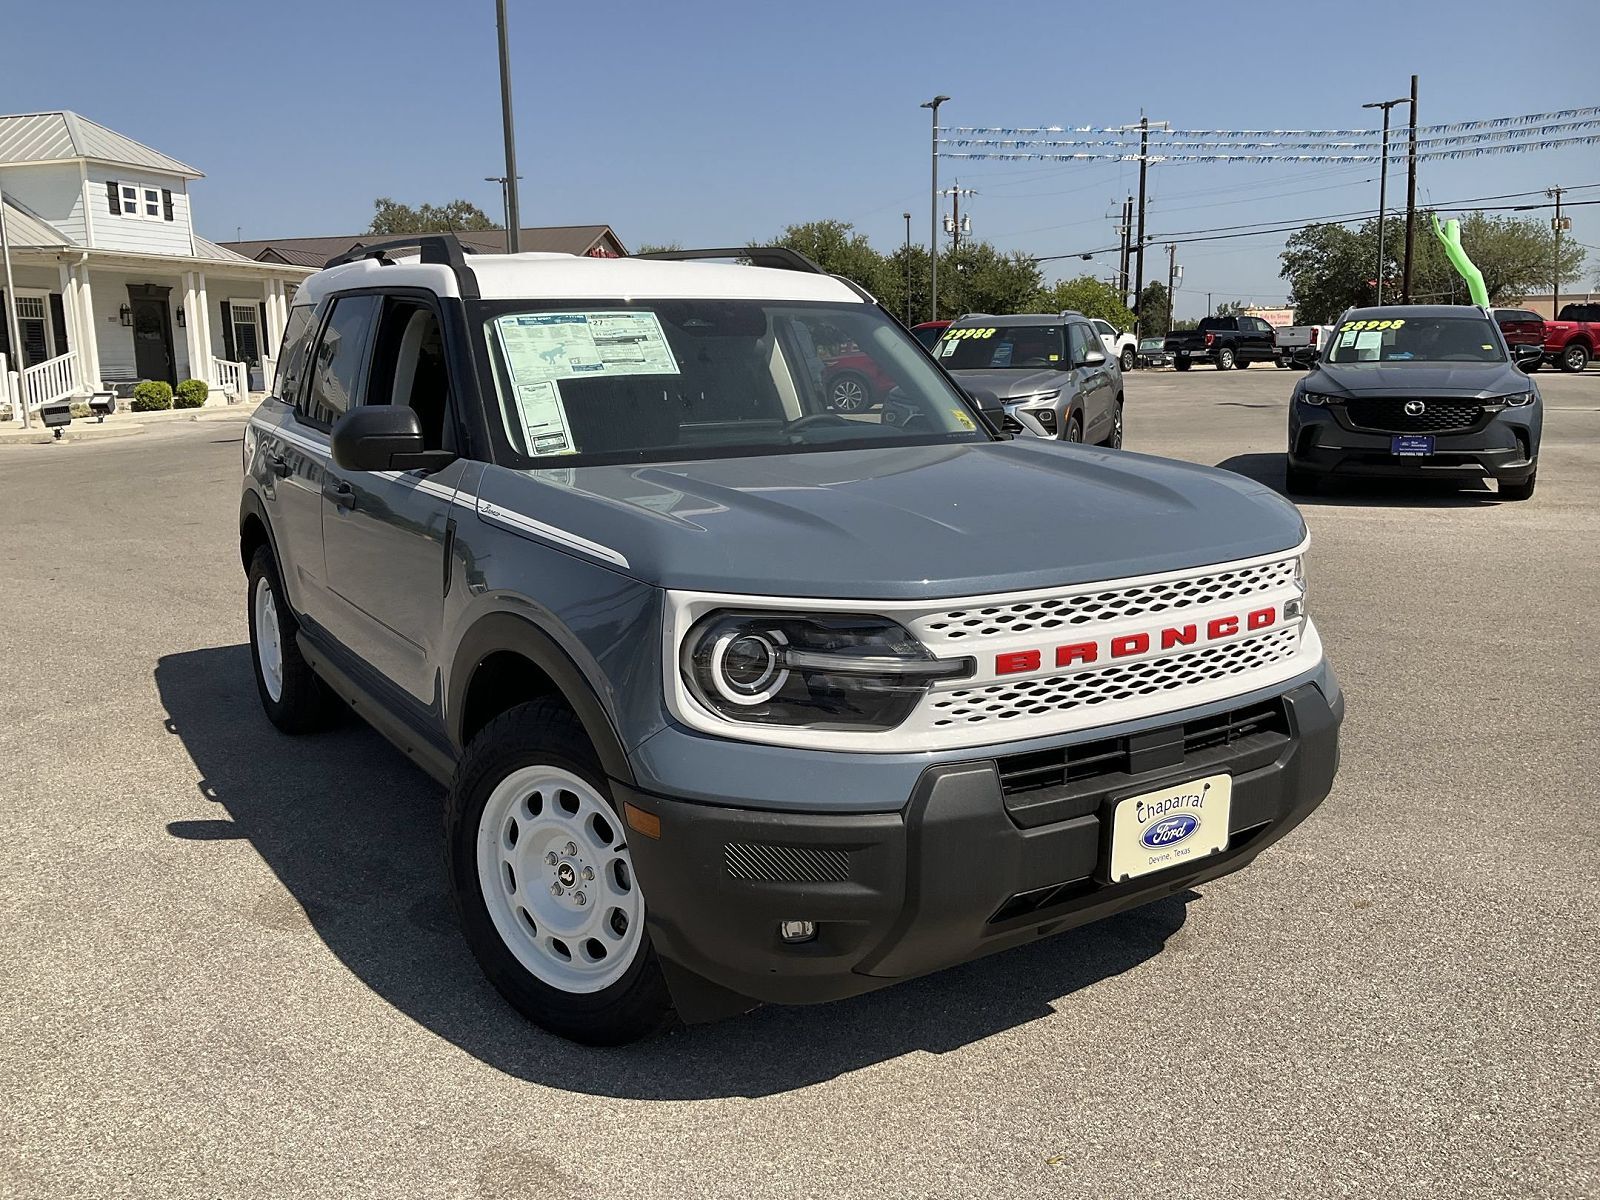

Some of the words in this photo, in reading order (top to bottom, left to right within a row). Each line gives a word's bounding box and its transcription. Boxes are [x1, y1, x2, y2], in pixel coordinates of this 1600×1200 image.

[943, 328, 996, 340] 29988
[1340, 319, 1405, 332] 28998
[481, 504, 500, 516] Bronco
[995, 606, 1276, 676] BRONCO
[1137, 789, 1206, 824] Chaparral
[1152, 819, 1186, 844] Ford
[1148, 853, 1172, 865] Devine,
[1173, 848, 1191, 858] Texas
